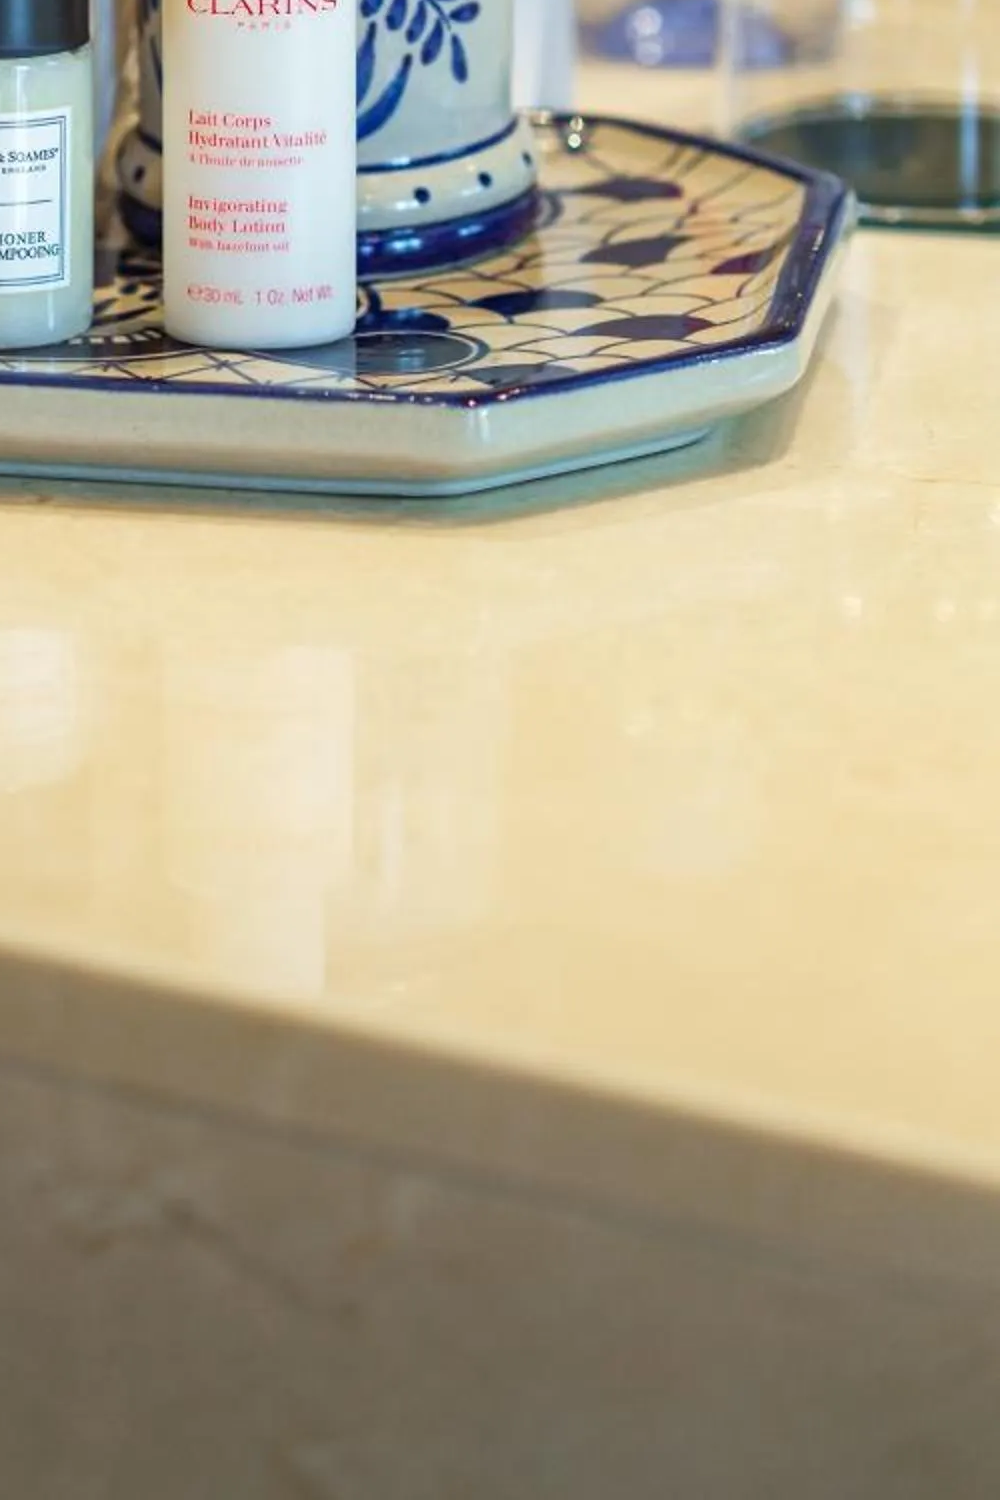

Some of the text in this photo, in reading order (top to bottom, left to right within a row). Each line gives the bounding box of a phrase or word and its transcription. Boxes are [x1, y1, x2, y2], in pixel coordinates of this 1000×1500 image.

[188, 109, 272, 132] Lait Corps
[188, 131, 268, 150] Hydratant
[188, 195, 288, 214] Invigorating
[188, 214, 286, 235] Body Lotion
[291, 286, 314, 302] Net
